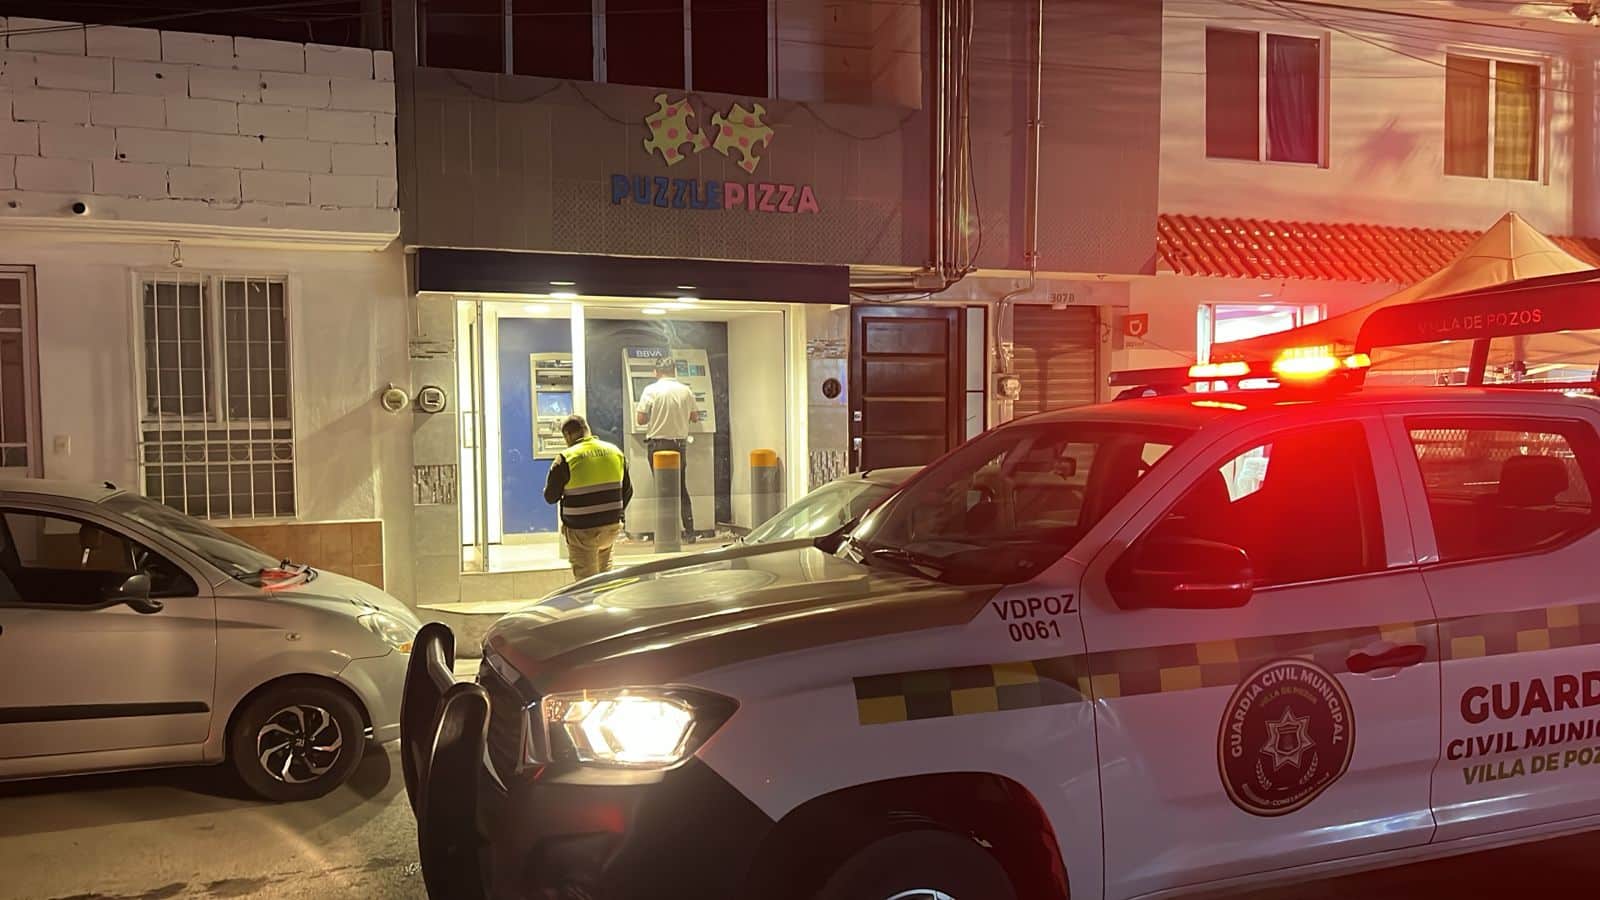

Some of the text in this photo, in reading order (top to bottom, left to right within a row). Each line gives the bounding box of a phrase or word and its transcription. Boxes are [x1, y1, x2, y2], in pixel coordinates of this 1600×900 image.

[1463, 315, 1483, 330] DE
[1487, 308, 1543, 326] POZOS
[635, 349, 662, 358] BBVA
[992, 593, 1078, 621] VDPOZ
[1008, 620, 1061, 642] 0061
[1231, 667, 1344, 758] GUARDIA CIVIL MUNICIPAL
[1460, 671, 1600, 724] GUARD
[1446, 719, 1600, 760] CIVIL MUNI
[1463, 758, 1526, 785] VILLA
[1531, 751, 1560, 774] DE
